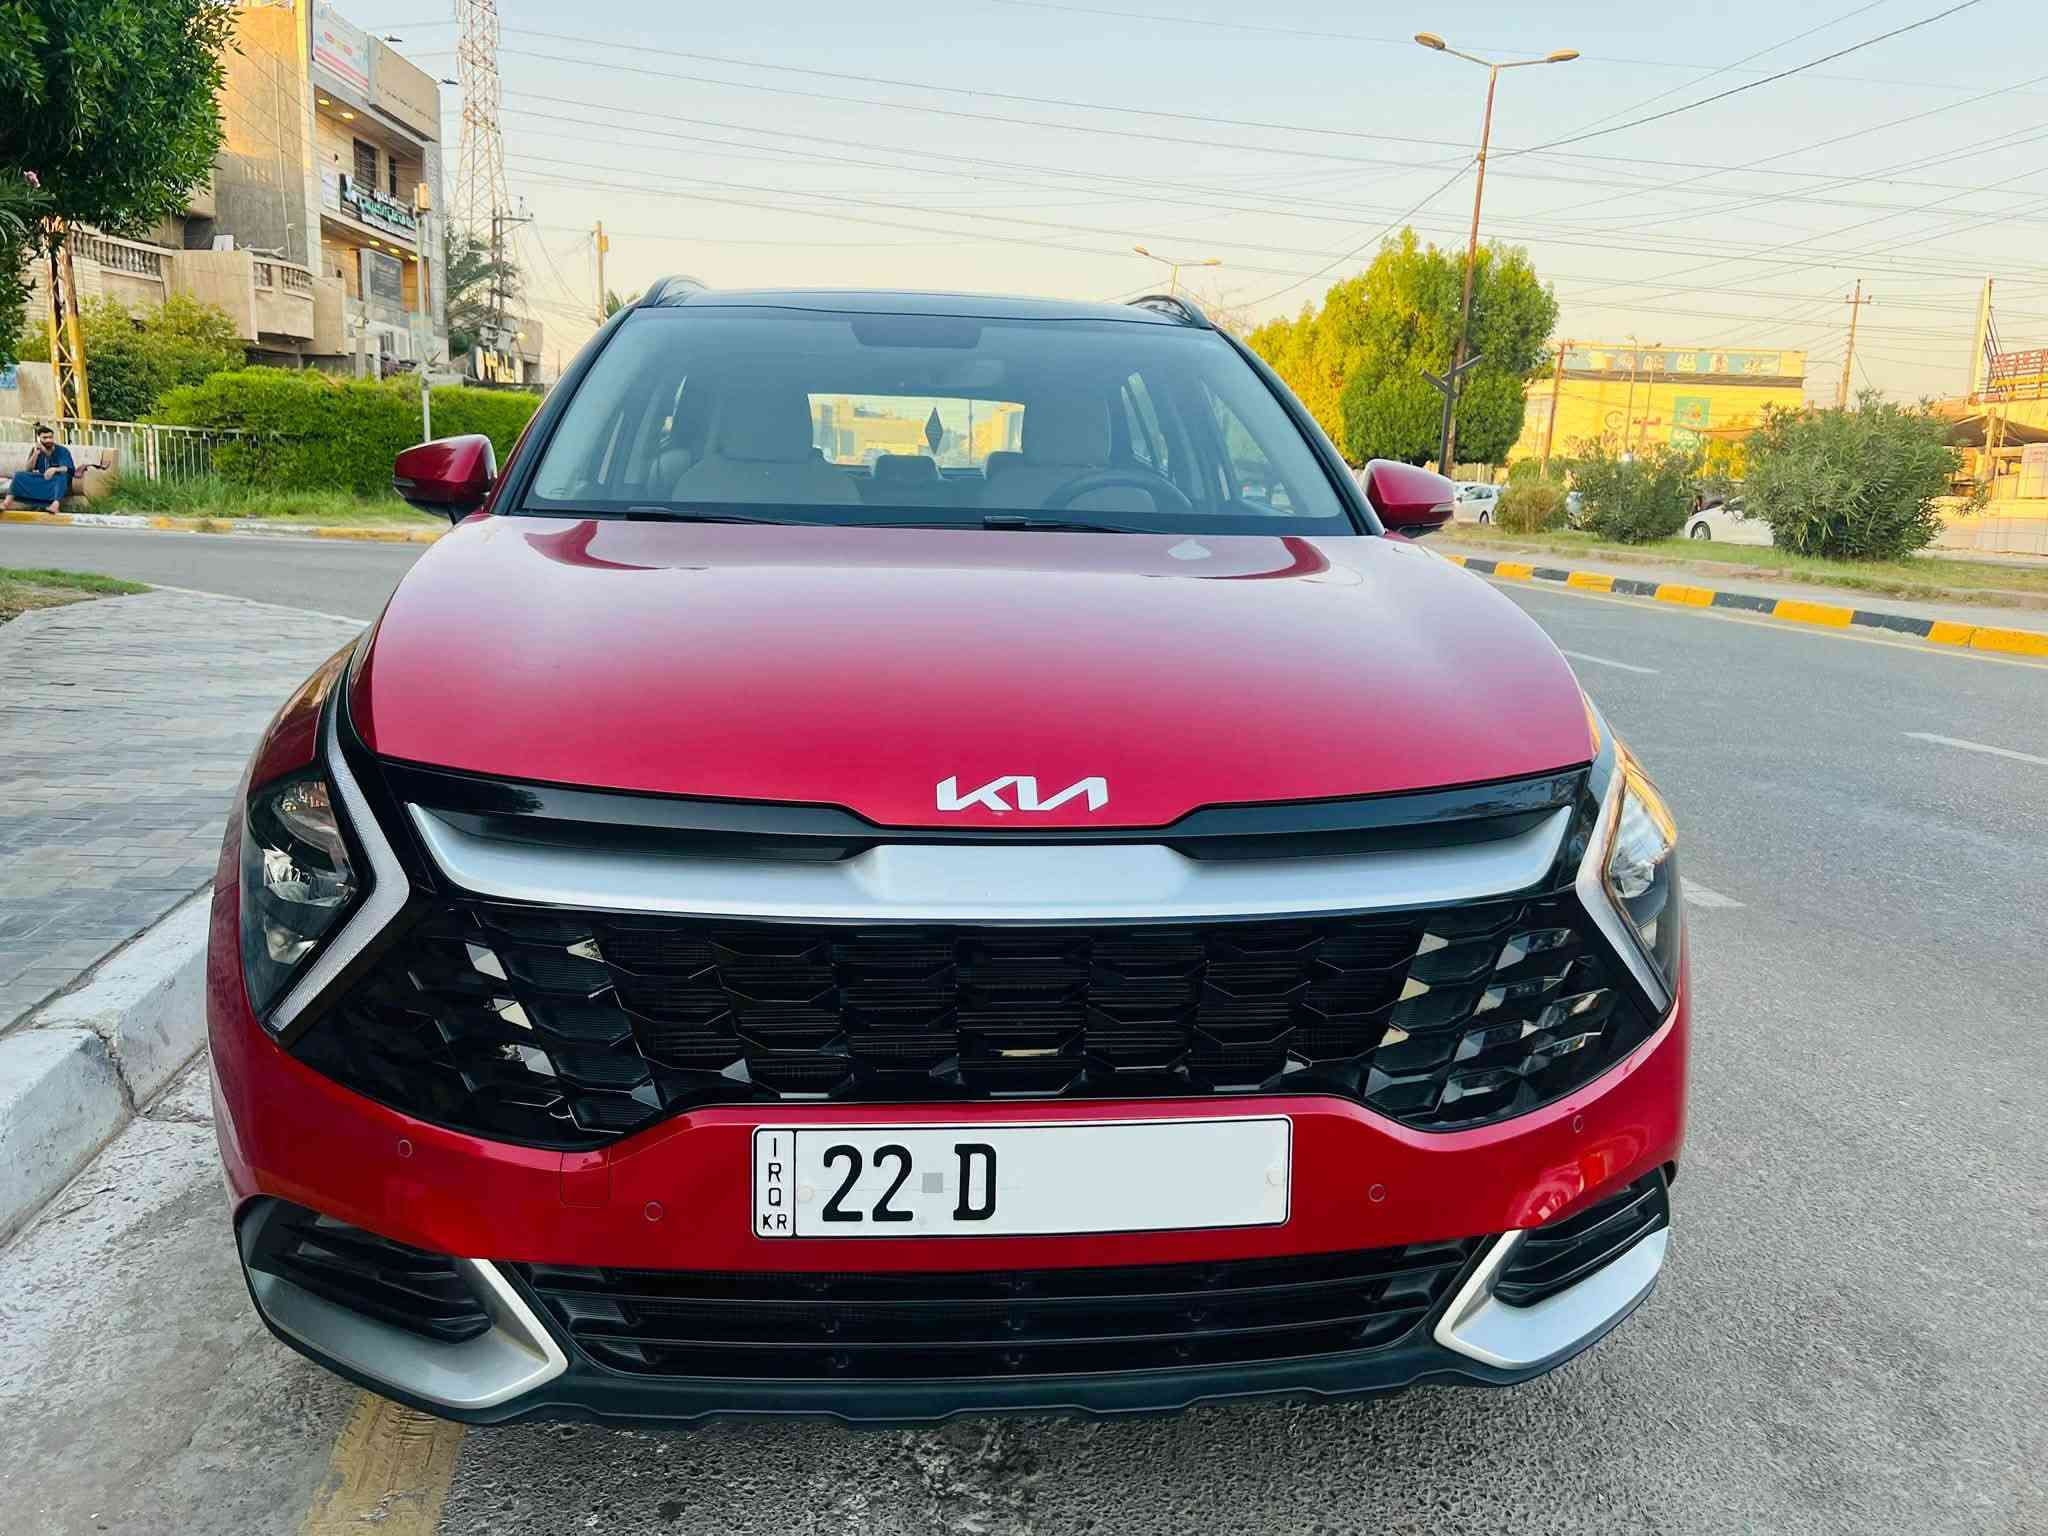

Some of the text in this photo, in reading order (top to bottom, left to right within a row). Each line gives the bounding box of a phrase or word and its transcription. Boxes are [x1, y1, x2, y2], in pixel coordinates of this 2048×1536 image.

[936, 775, 1109, 812] KIA
[822, 1143, 997, 1222] 22 D
[762, 1213, 787, 1230] KR
